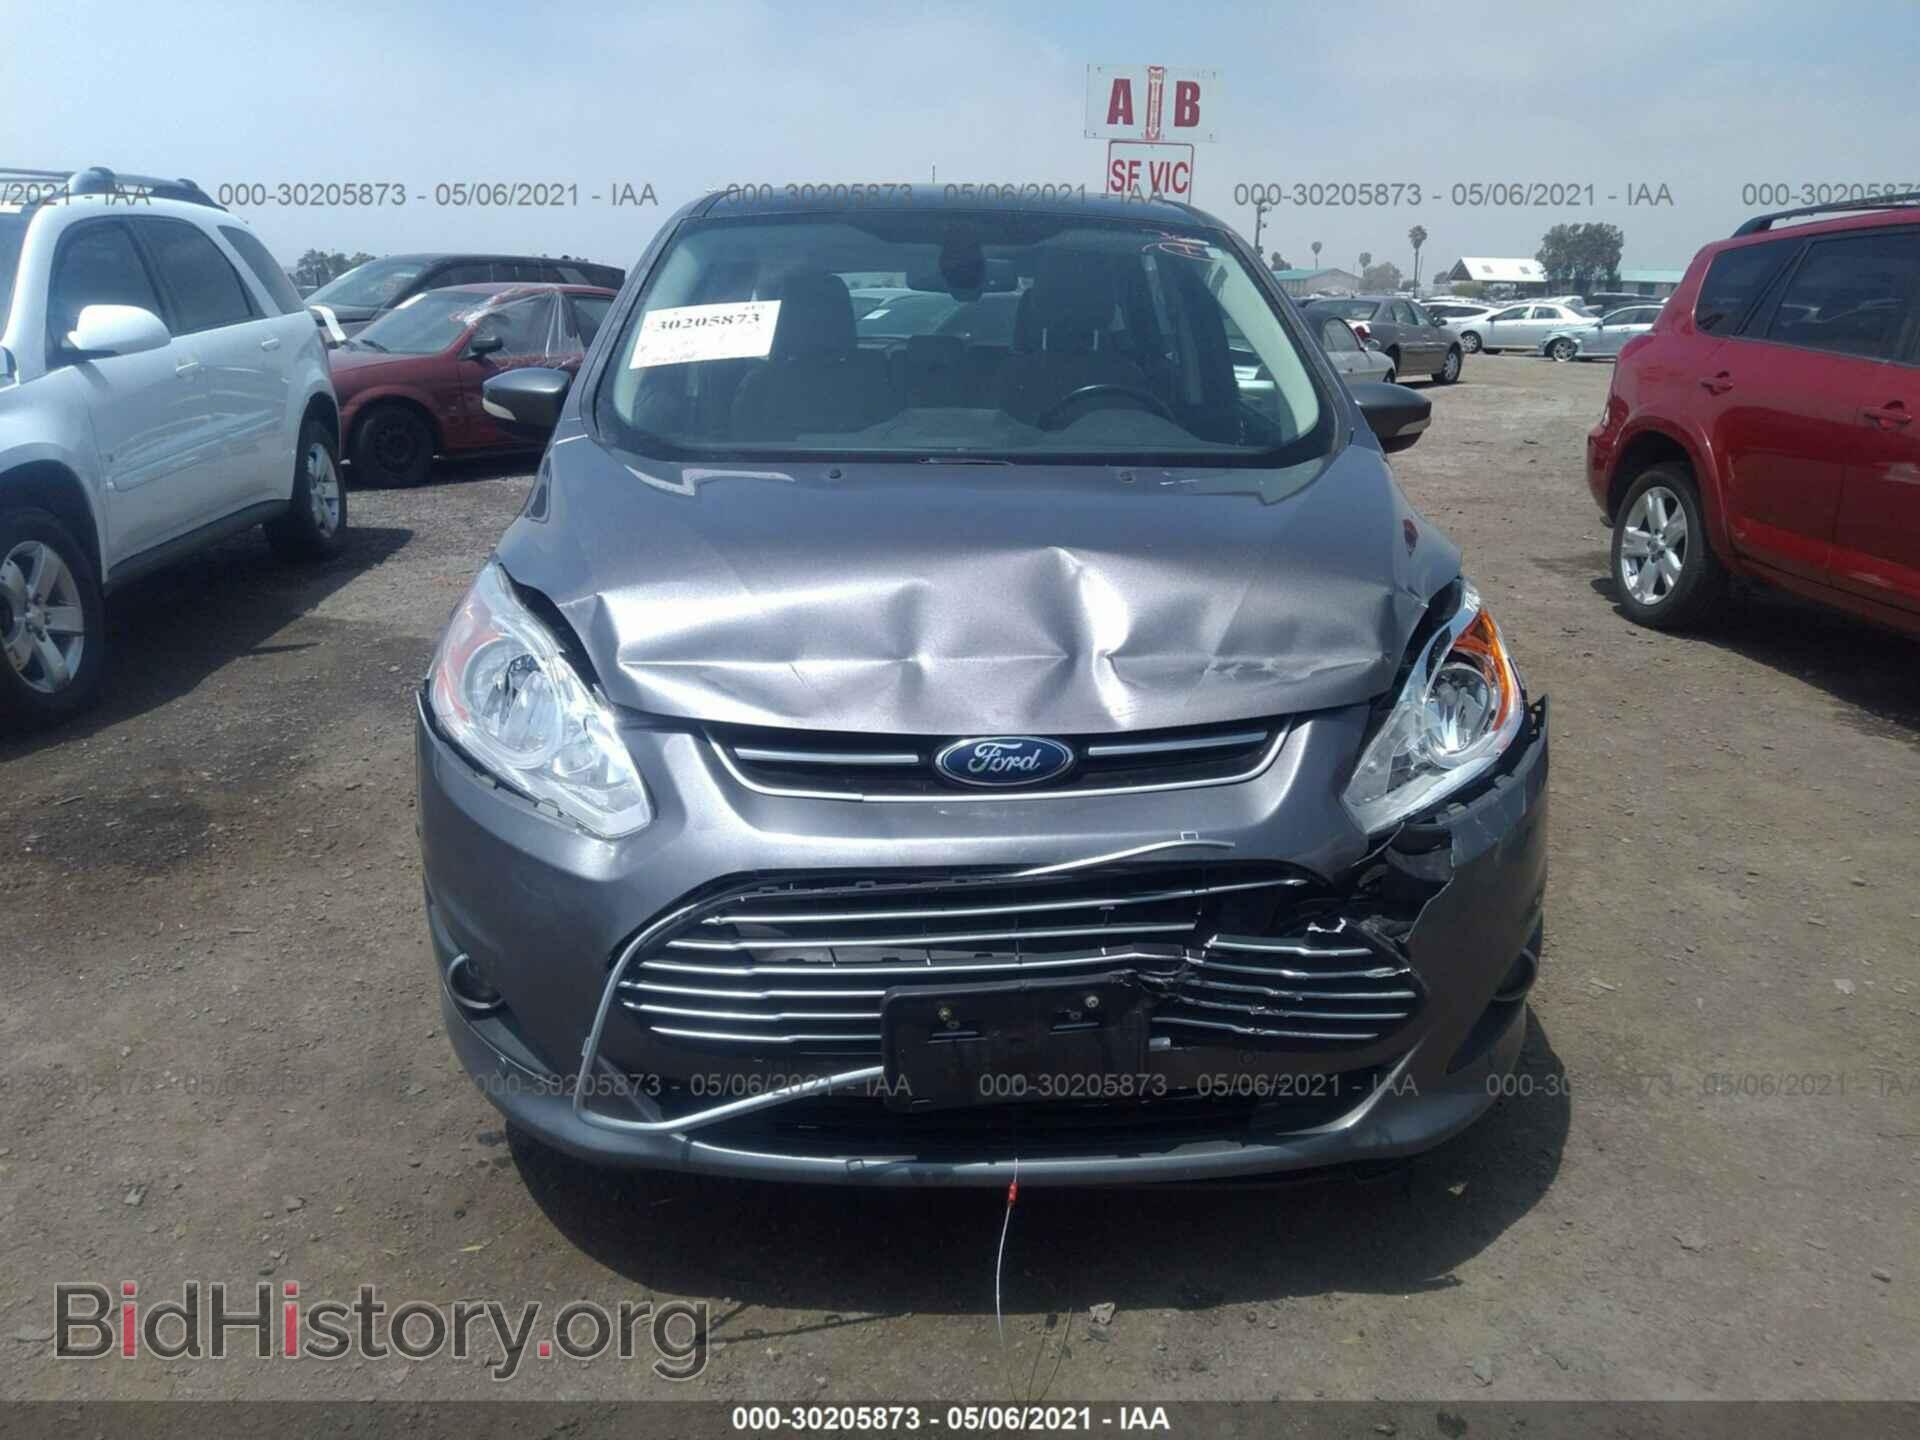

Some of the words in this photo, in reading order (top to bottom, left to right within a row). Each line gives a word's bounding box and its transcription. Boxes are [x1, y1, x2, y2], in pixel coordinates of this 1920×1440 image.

[1107, 78, 1134, 125] A
[1173, 80, 1201, 127] B
[1110, 159, 1142, 193] SF
[1149, 160, 1189, 194] VIC
[655, 313, 761, 332] 30205873
[967, 742, 1043, 773] Ford
